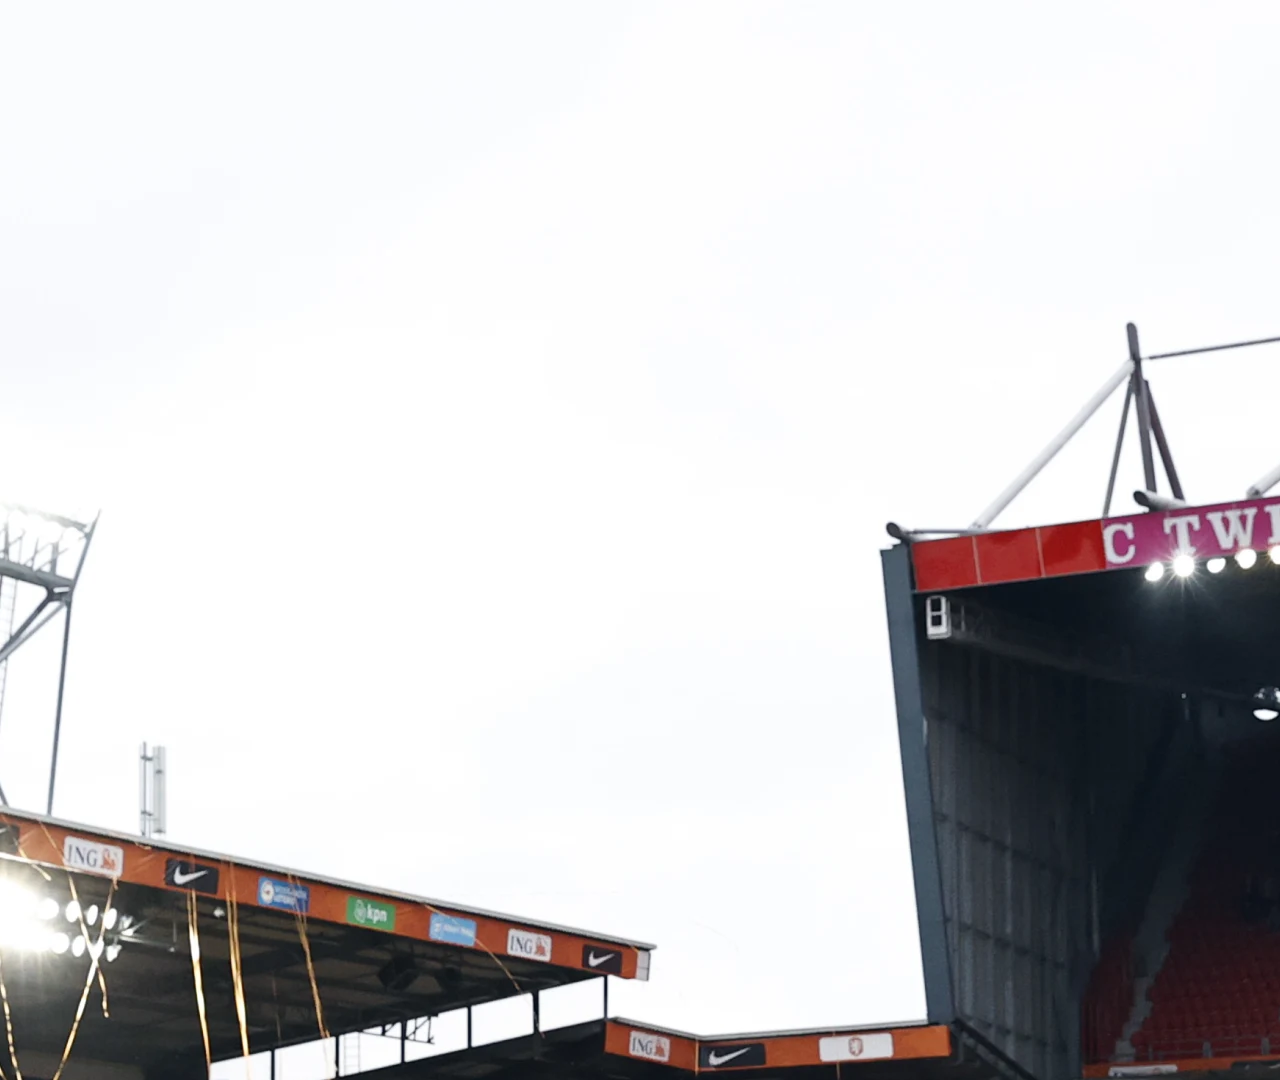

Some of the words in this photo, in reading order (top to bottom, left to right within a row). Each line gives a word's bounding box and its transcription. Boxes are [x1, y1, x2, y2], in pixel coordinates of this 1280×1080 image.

[67, 846, 97, 868] ING
[367, 905, 387, 923] kpn
[509, 934, 533, 954] ING
[632, 1035, 654, 1055] ING
